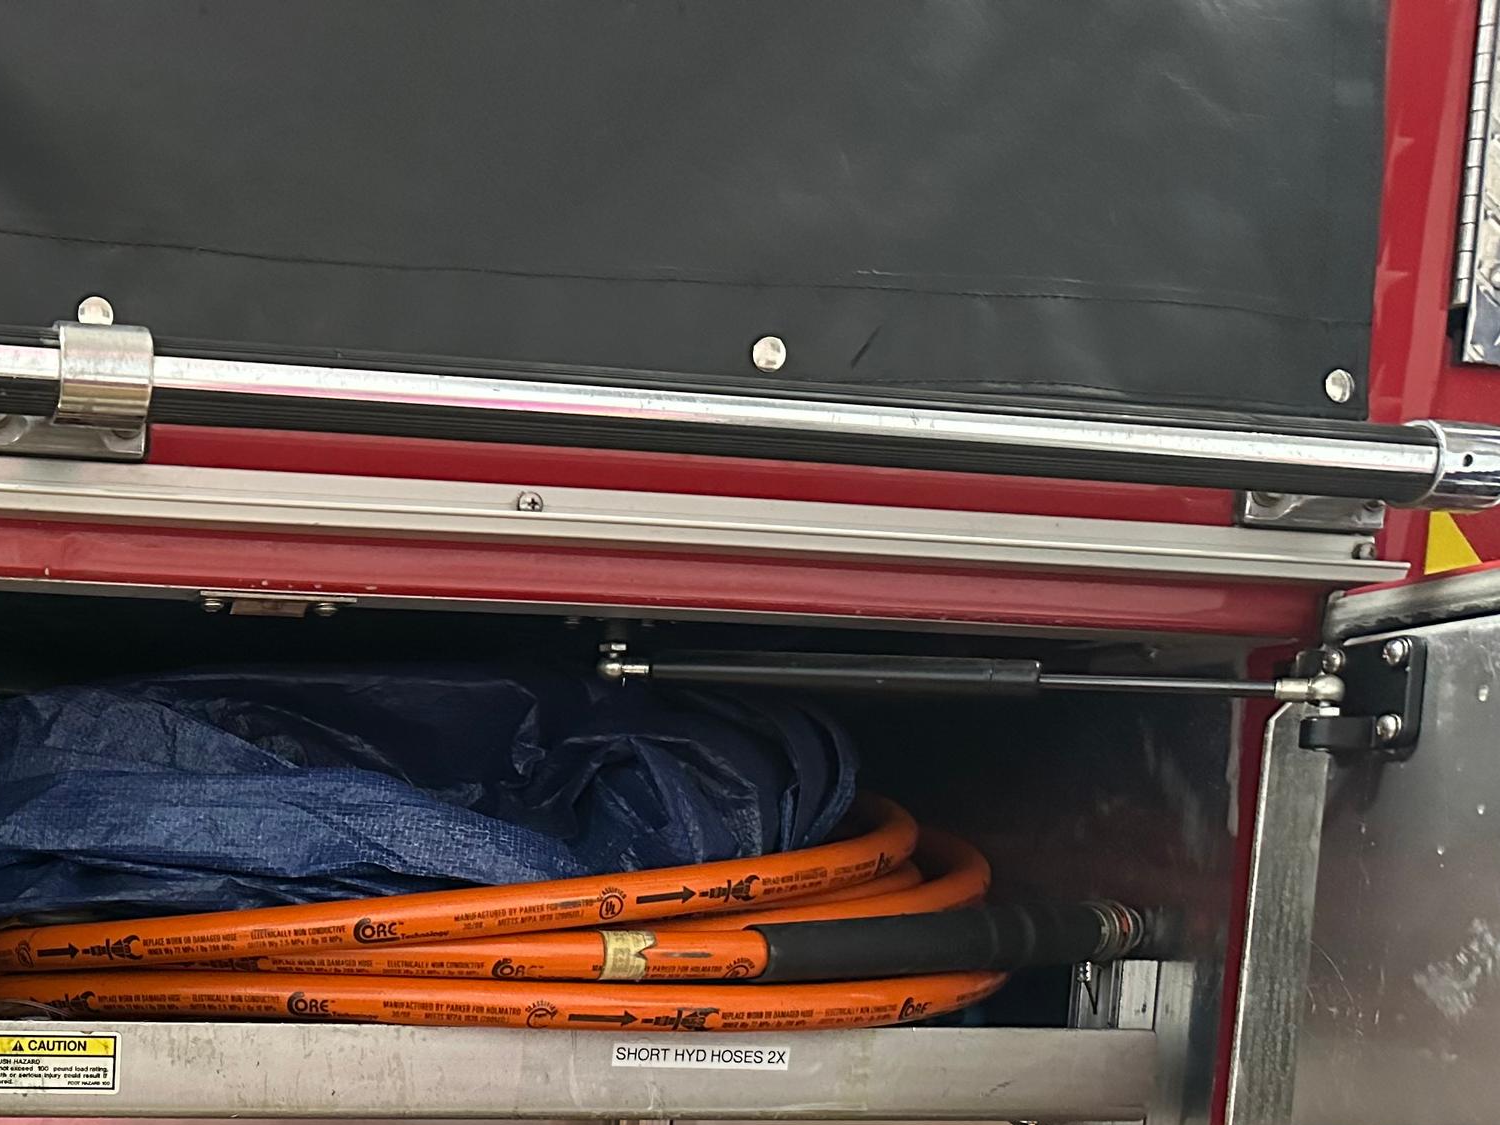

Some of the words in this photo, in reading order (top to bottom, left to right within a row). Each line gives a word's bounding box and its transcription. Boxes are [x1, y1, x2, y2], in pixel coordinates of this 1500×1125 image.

[454, 908, 506, 923] MANUFACTURED
[508, 907, 518, 917] BY
[519, 904, 545, 916] PARKER
[251, 928, 293, 941] ELECTRICALLY
[294, 928, 307, 937] NON
[308, 925, 346, 936] CONDUCTIVE
[353, 918, 399, 944] CORE
[400, 930, 450, 940] Technology
[143, 937, 165, 947] REPLACE
[166, 936, 183, 946] WORN
[184, 936, 191, 945] OR
[193, 935, 221, 944] DAMAGED
[222, 934, 237, 942] HOSE
[287, 992, 329, 1016] CORE
[383, 1001, 434, 1011] MANUFACTURED
[436, 1003, 444, 1012] BY
[446, 1004, 470, 1013] PARKER
[472, 1004, 484, 1014] FOR
[486, 1005, 522, 1017] HOLMATRO
[28, 1040, 87, 1052] CAUTION
[616, 1047, 670, 1062] SHORT
[675, 1048, 707, 1062] HYD
[711, 1050, 764, 1064] HOSES
[768, 1051, 786, 1064] 2X
[44, 1072, 61, 1080] injury
